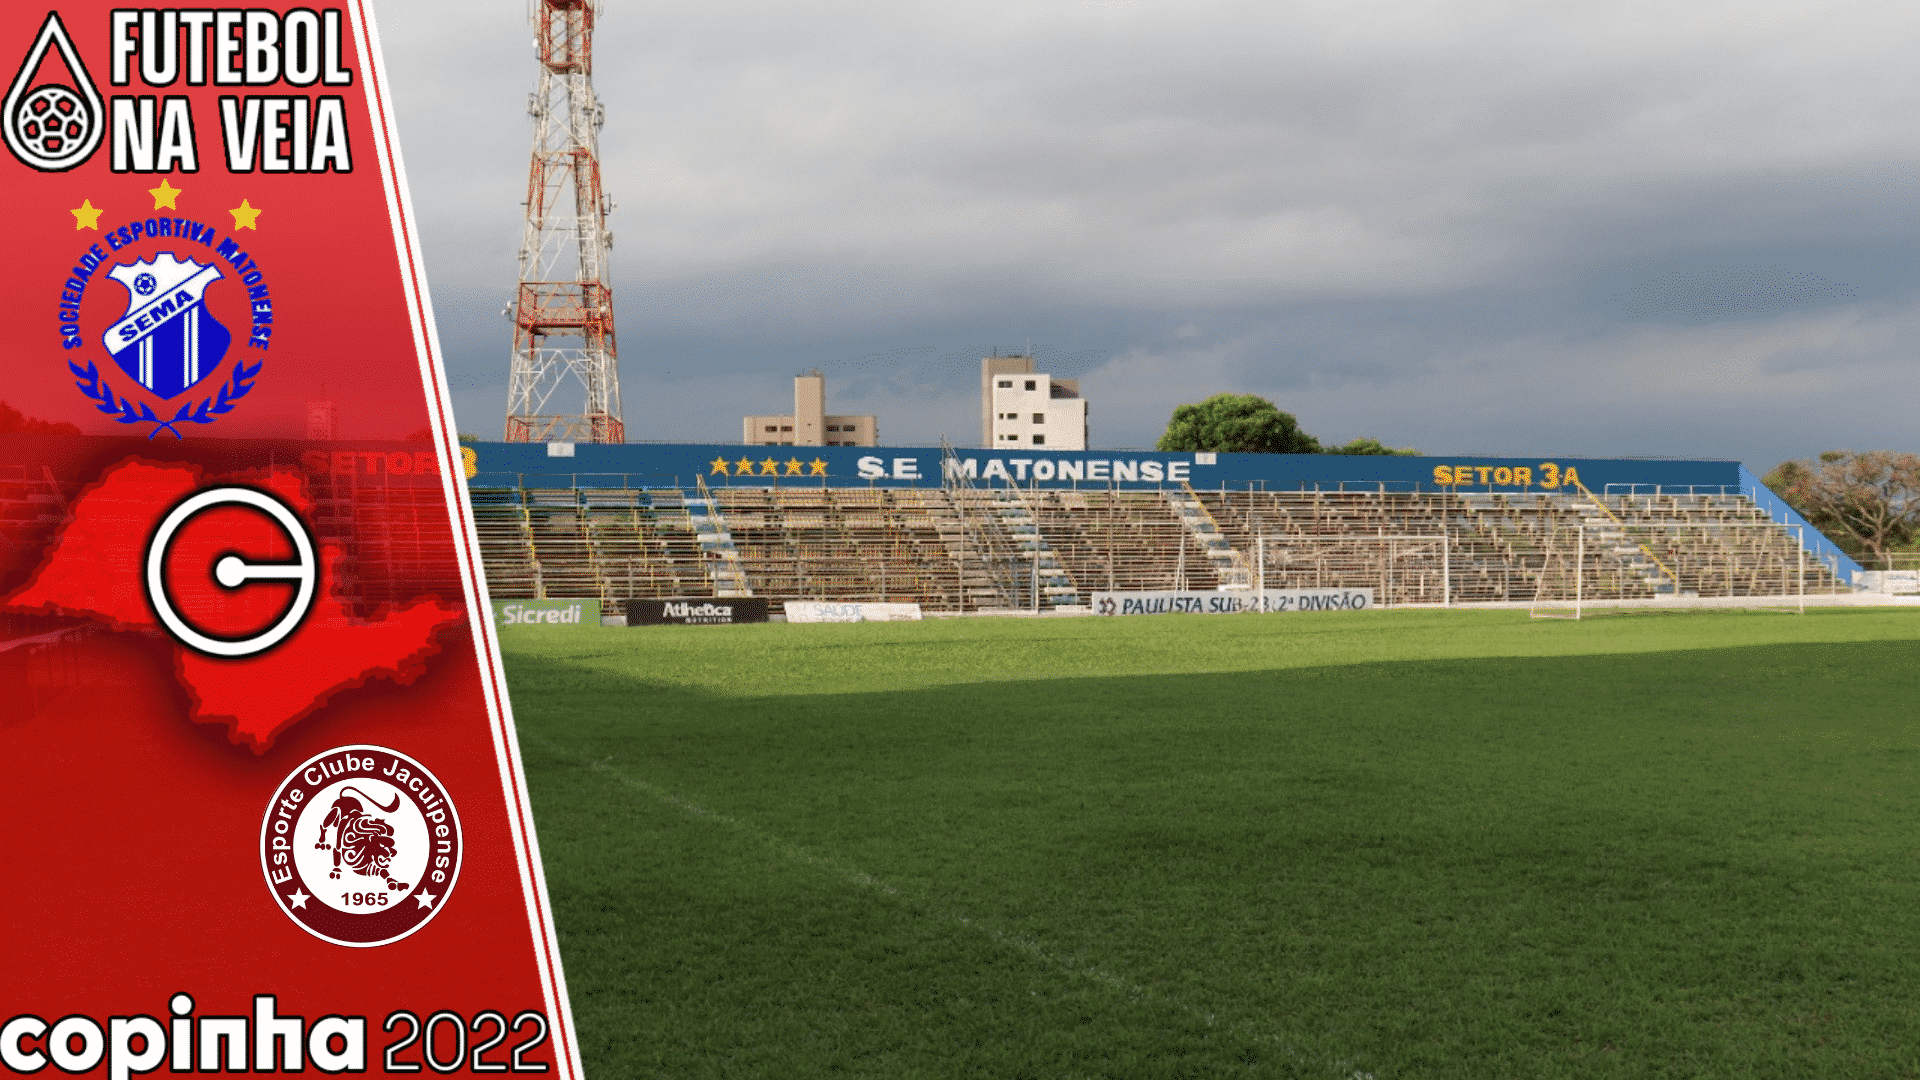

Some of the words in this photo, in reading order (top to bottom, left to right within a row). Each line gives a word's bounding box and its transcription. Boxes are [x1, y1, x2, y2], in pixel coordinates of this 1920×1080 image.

[857, 456, 922, 479] S.E.
[946, 458, 1191, 482] MATONENSE
[1433, 464, 1533, 487] SETOR
[502, 604, 580, 624] Sicredi
[1122, 598, 1201, 615] PAULISTA
[1299, 591, 1367, 611] DIVISÃO
